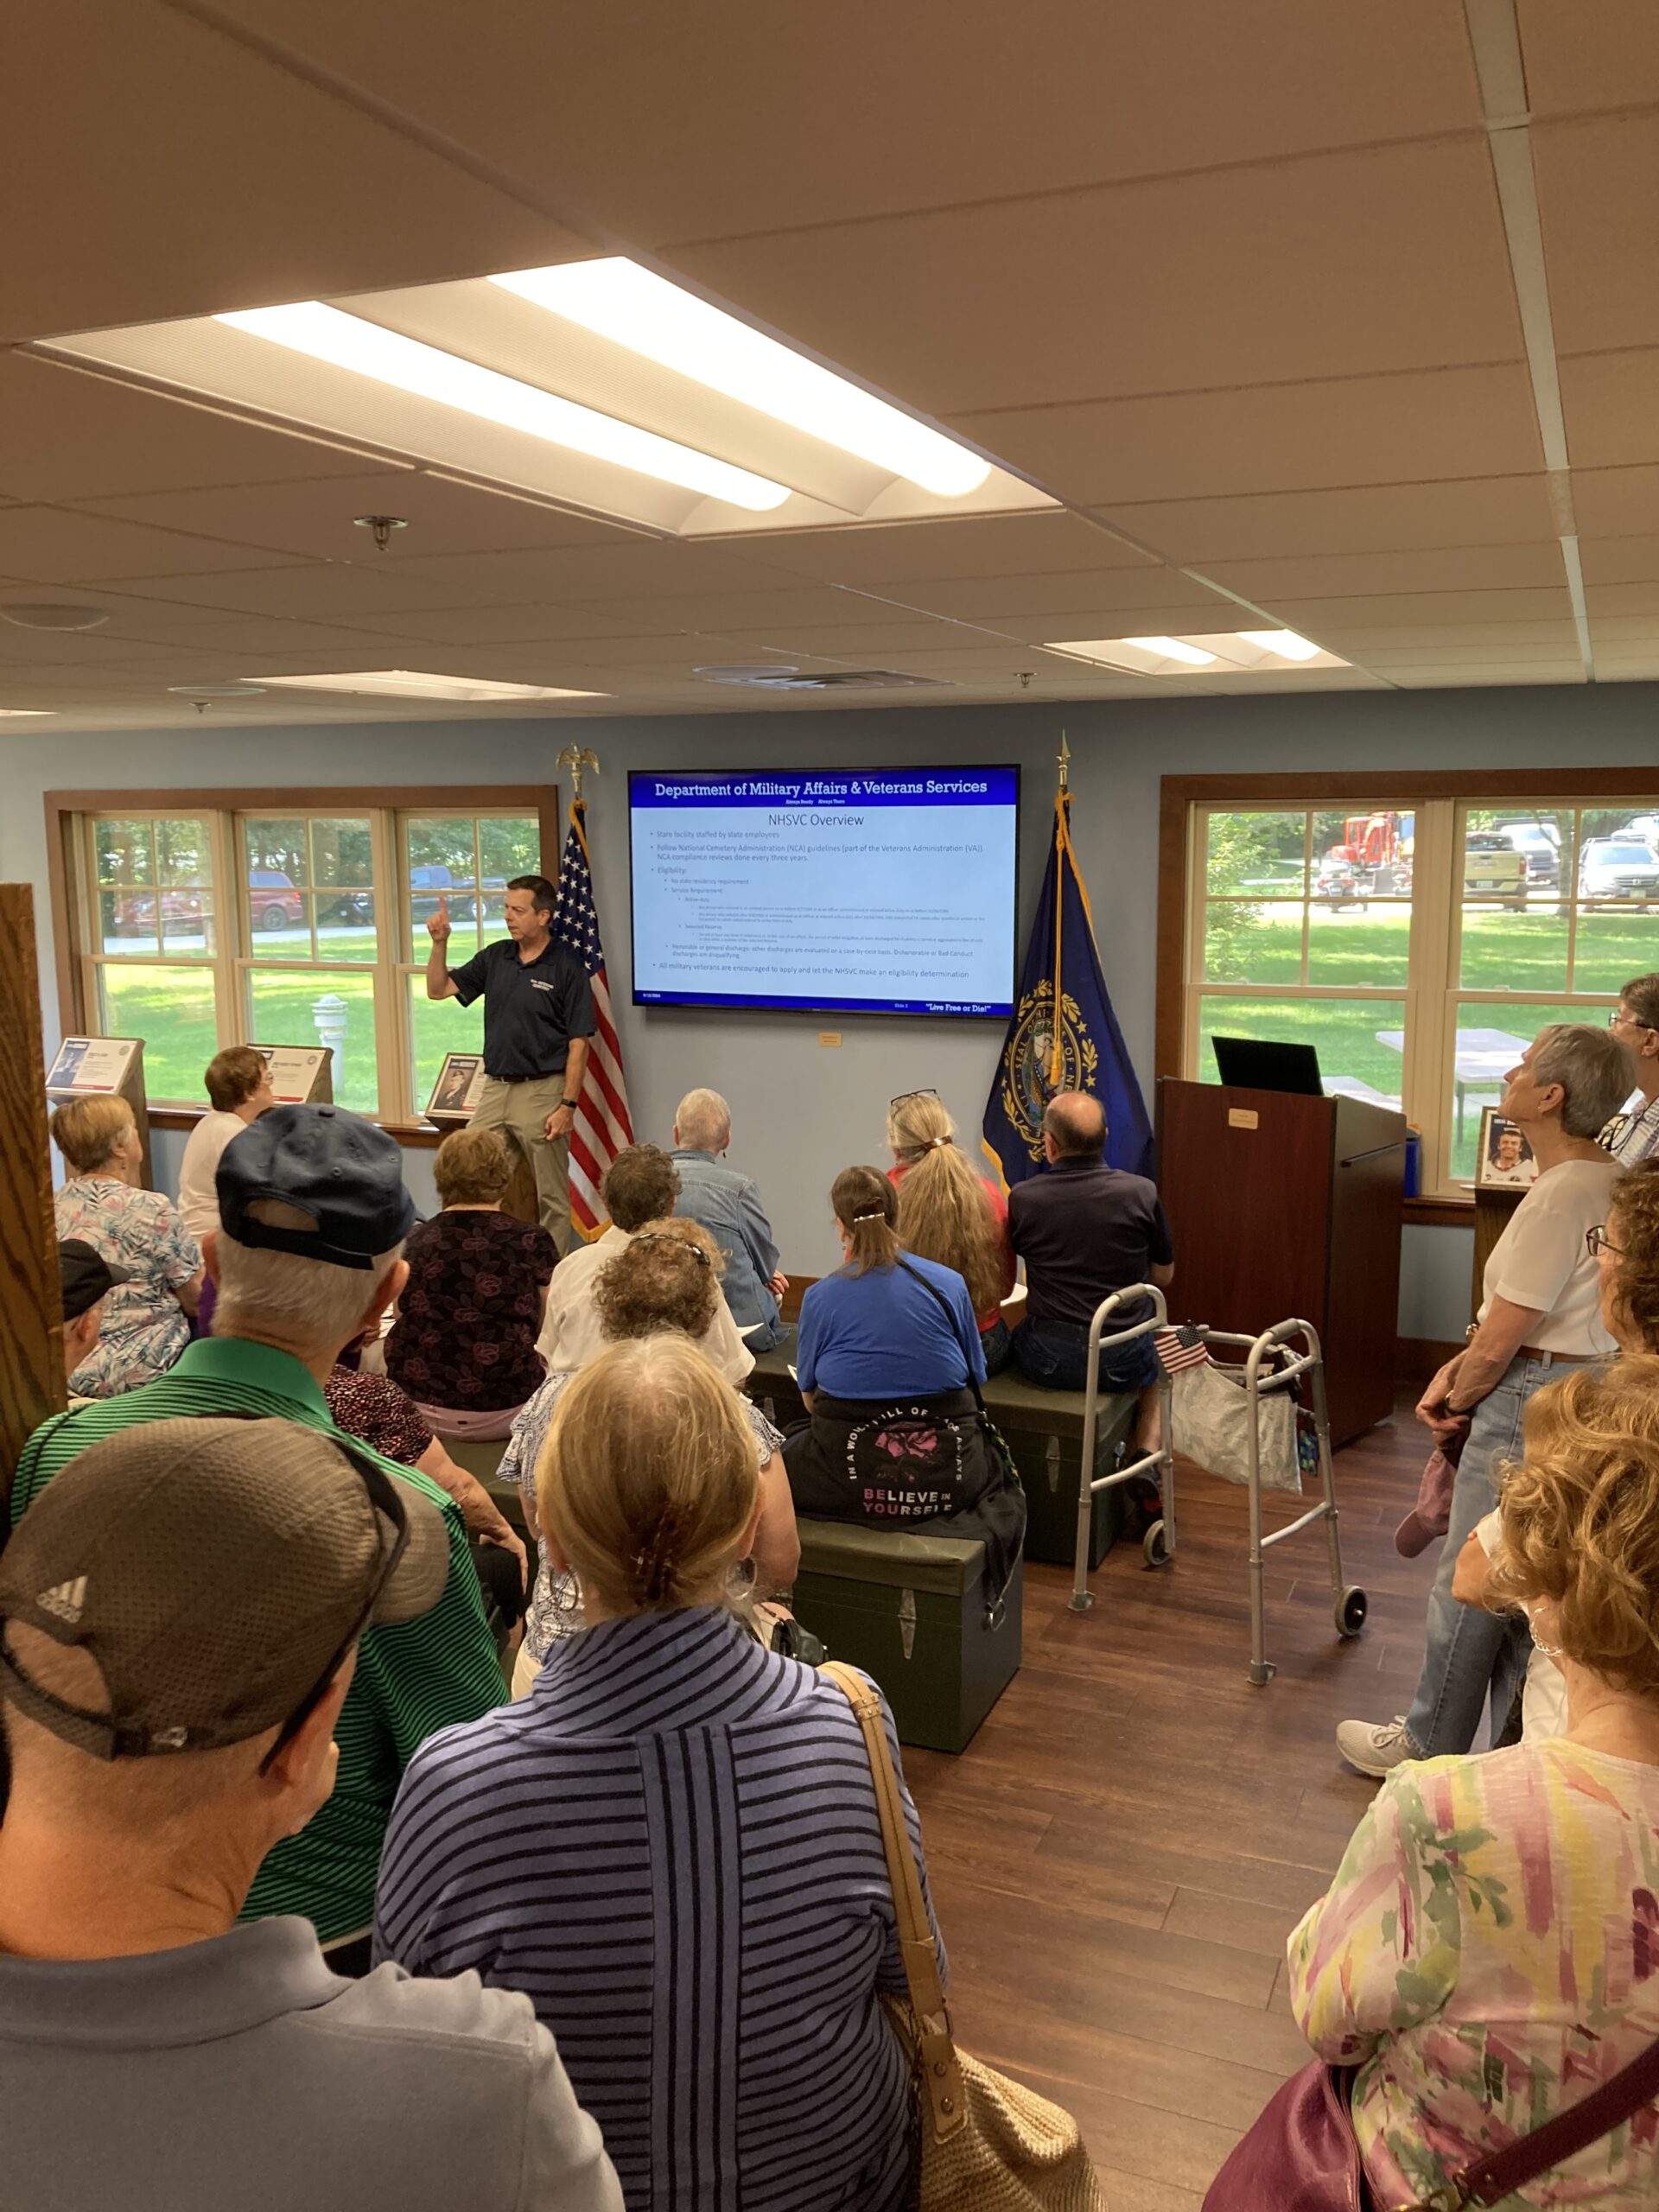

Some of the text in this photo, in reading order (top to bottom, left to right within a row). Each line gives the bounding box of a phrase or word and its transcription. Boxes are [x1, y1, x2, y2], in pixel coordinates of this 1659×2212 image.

[655, 779, 988, 799] Department of Military Affairs & Veterans Services
[768, 813, 864, 826] NHSVC Overview
[674, 830, 695, 839] facility
[719, 830, 726, 840] by
[745, 830, 779, 839] employees
[706, 844, 736, 854] Cemetery
[786, 844, 806, 854] (NCA)
[807, 845, 841, 854] guidelines
[842, 845, 859, 854] (part
[669, 963, 692, 972] military
[733, 965, 770, 974] encouraged
[779, 967, 797, 976] apply
[888, 969, 918, 978] eligibility
[945, 1003, 962, 1012] Free
[1065, 1047, 1075, 1063] OF
[848, 1467, 858, 1480] IN
[910, 1407, 929, 1417] OF
[863, 1488, 951, 1503] BELIEVE IN
